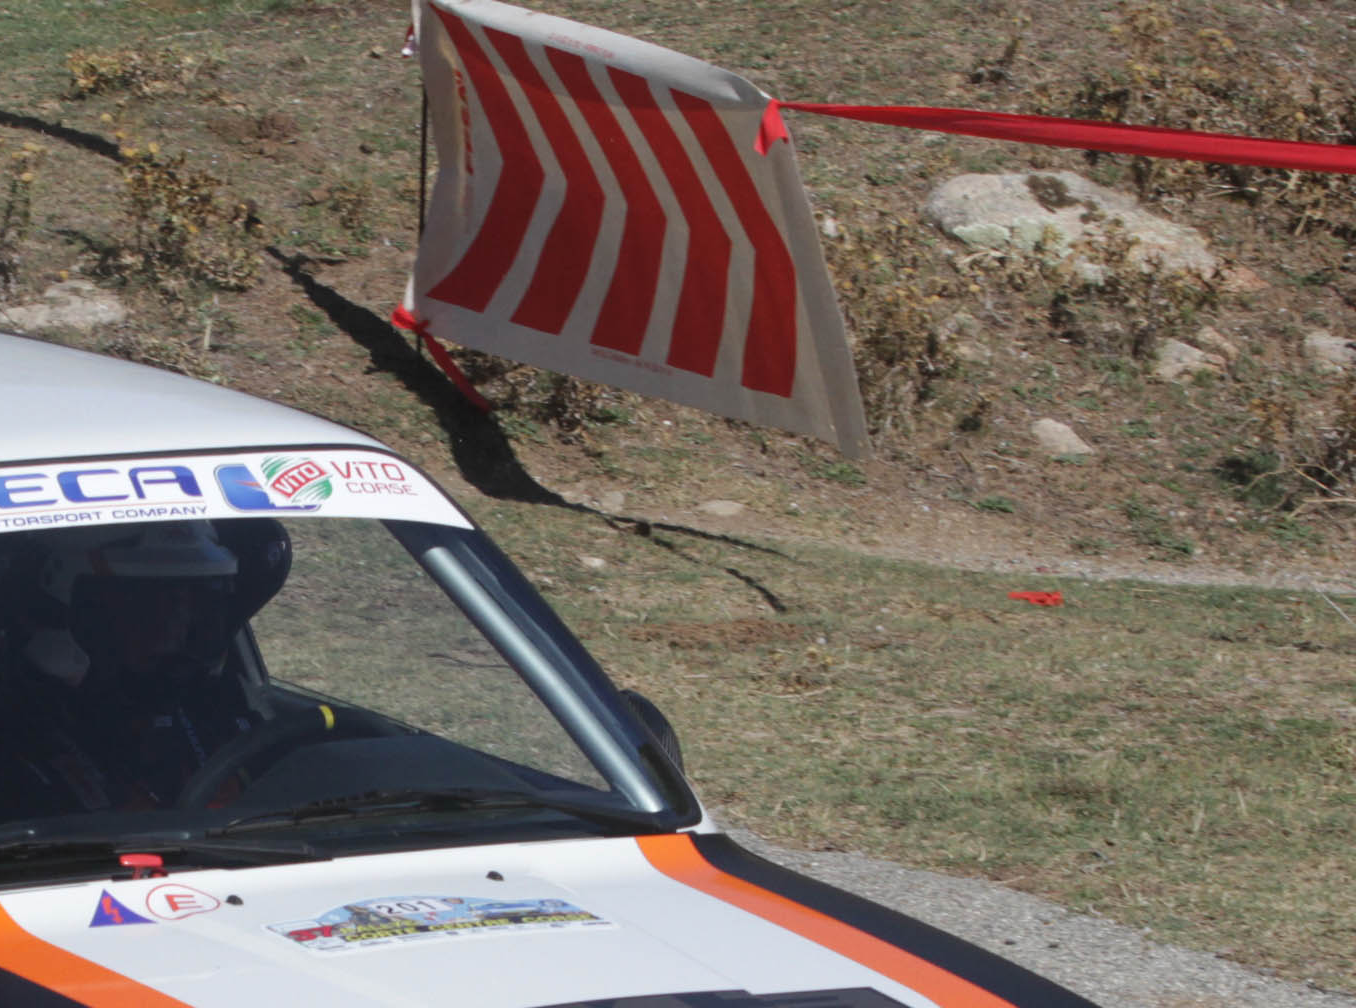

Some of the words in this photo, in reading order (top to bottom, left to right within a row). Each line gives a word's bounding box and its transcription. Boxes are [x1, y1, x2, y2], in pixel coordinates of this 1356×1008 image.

[346, 482, 419, 496] CORSE
[112, 504, 208, 519] COMPANY
[164, 894, 203, 912] E
[377, 899, 438, 915] 201
